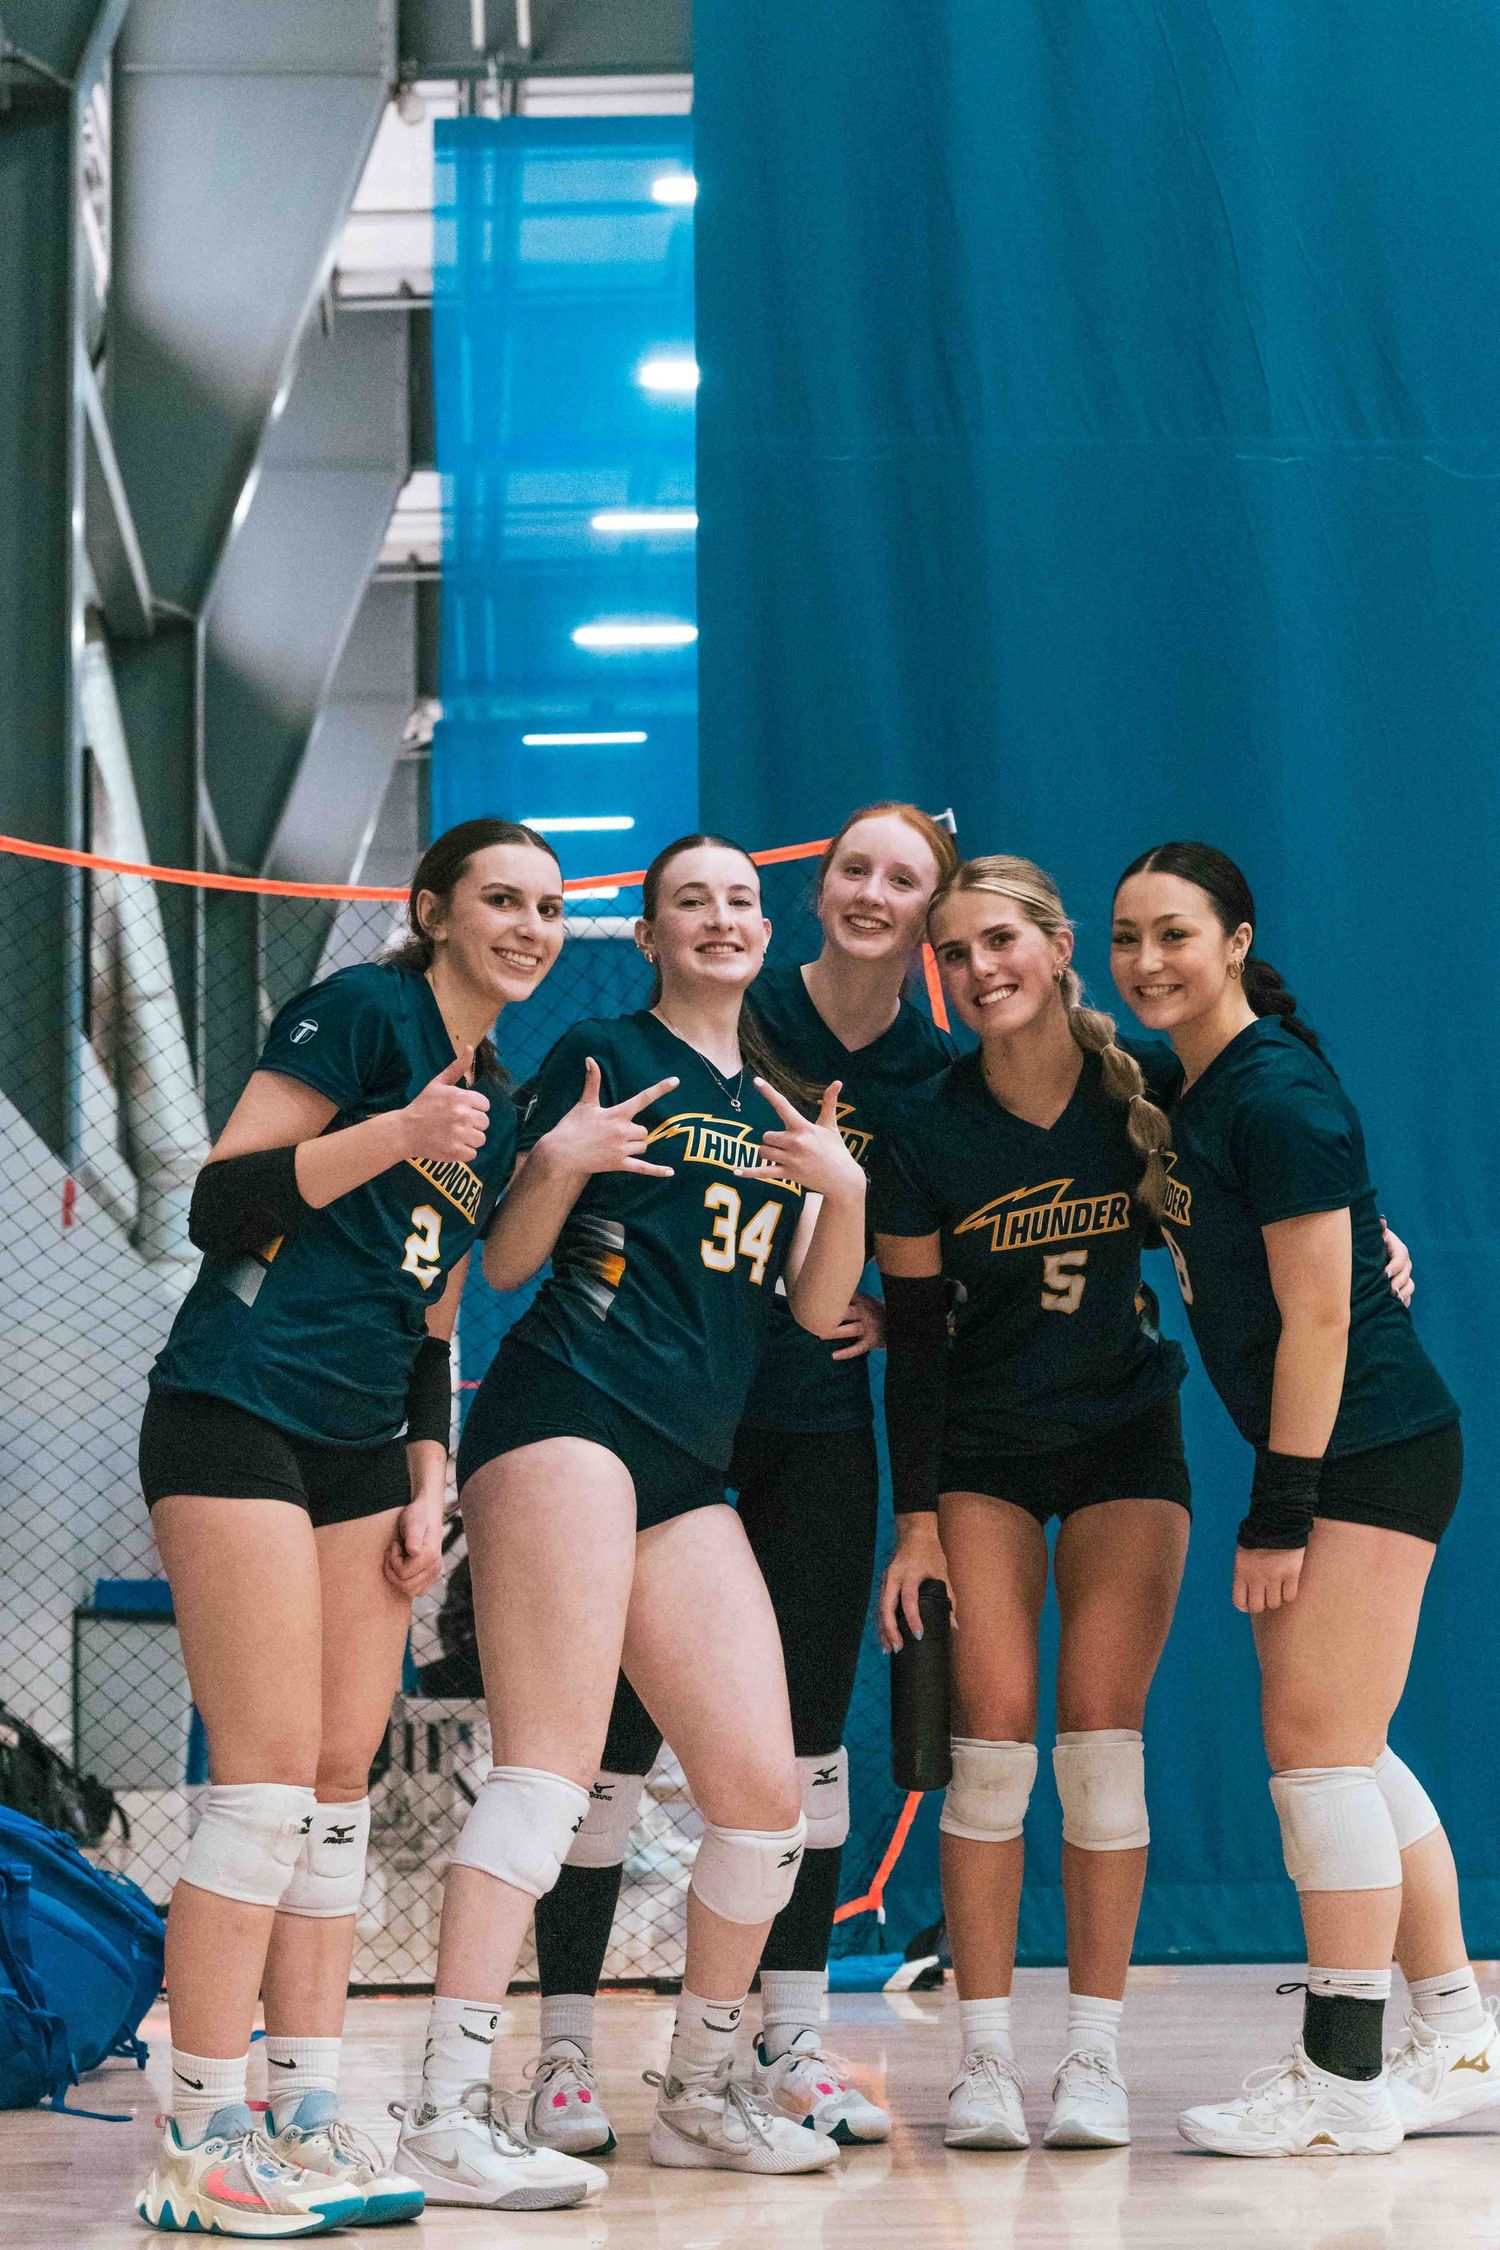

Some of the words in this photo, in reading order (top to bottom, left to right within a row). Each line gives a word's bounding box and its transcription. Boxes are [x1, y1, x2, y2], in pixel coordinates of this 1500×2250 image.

[401, 1204, 442, 1290] 2
[701, 1183, 782, 1285] 34
[955, 1180, 1130, 1251] THUNDER
[1041, 1250, 1087, 1314] 5
